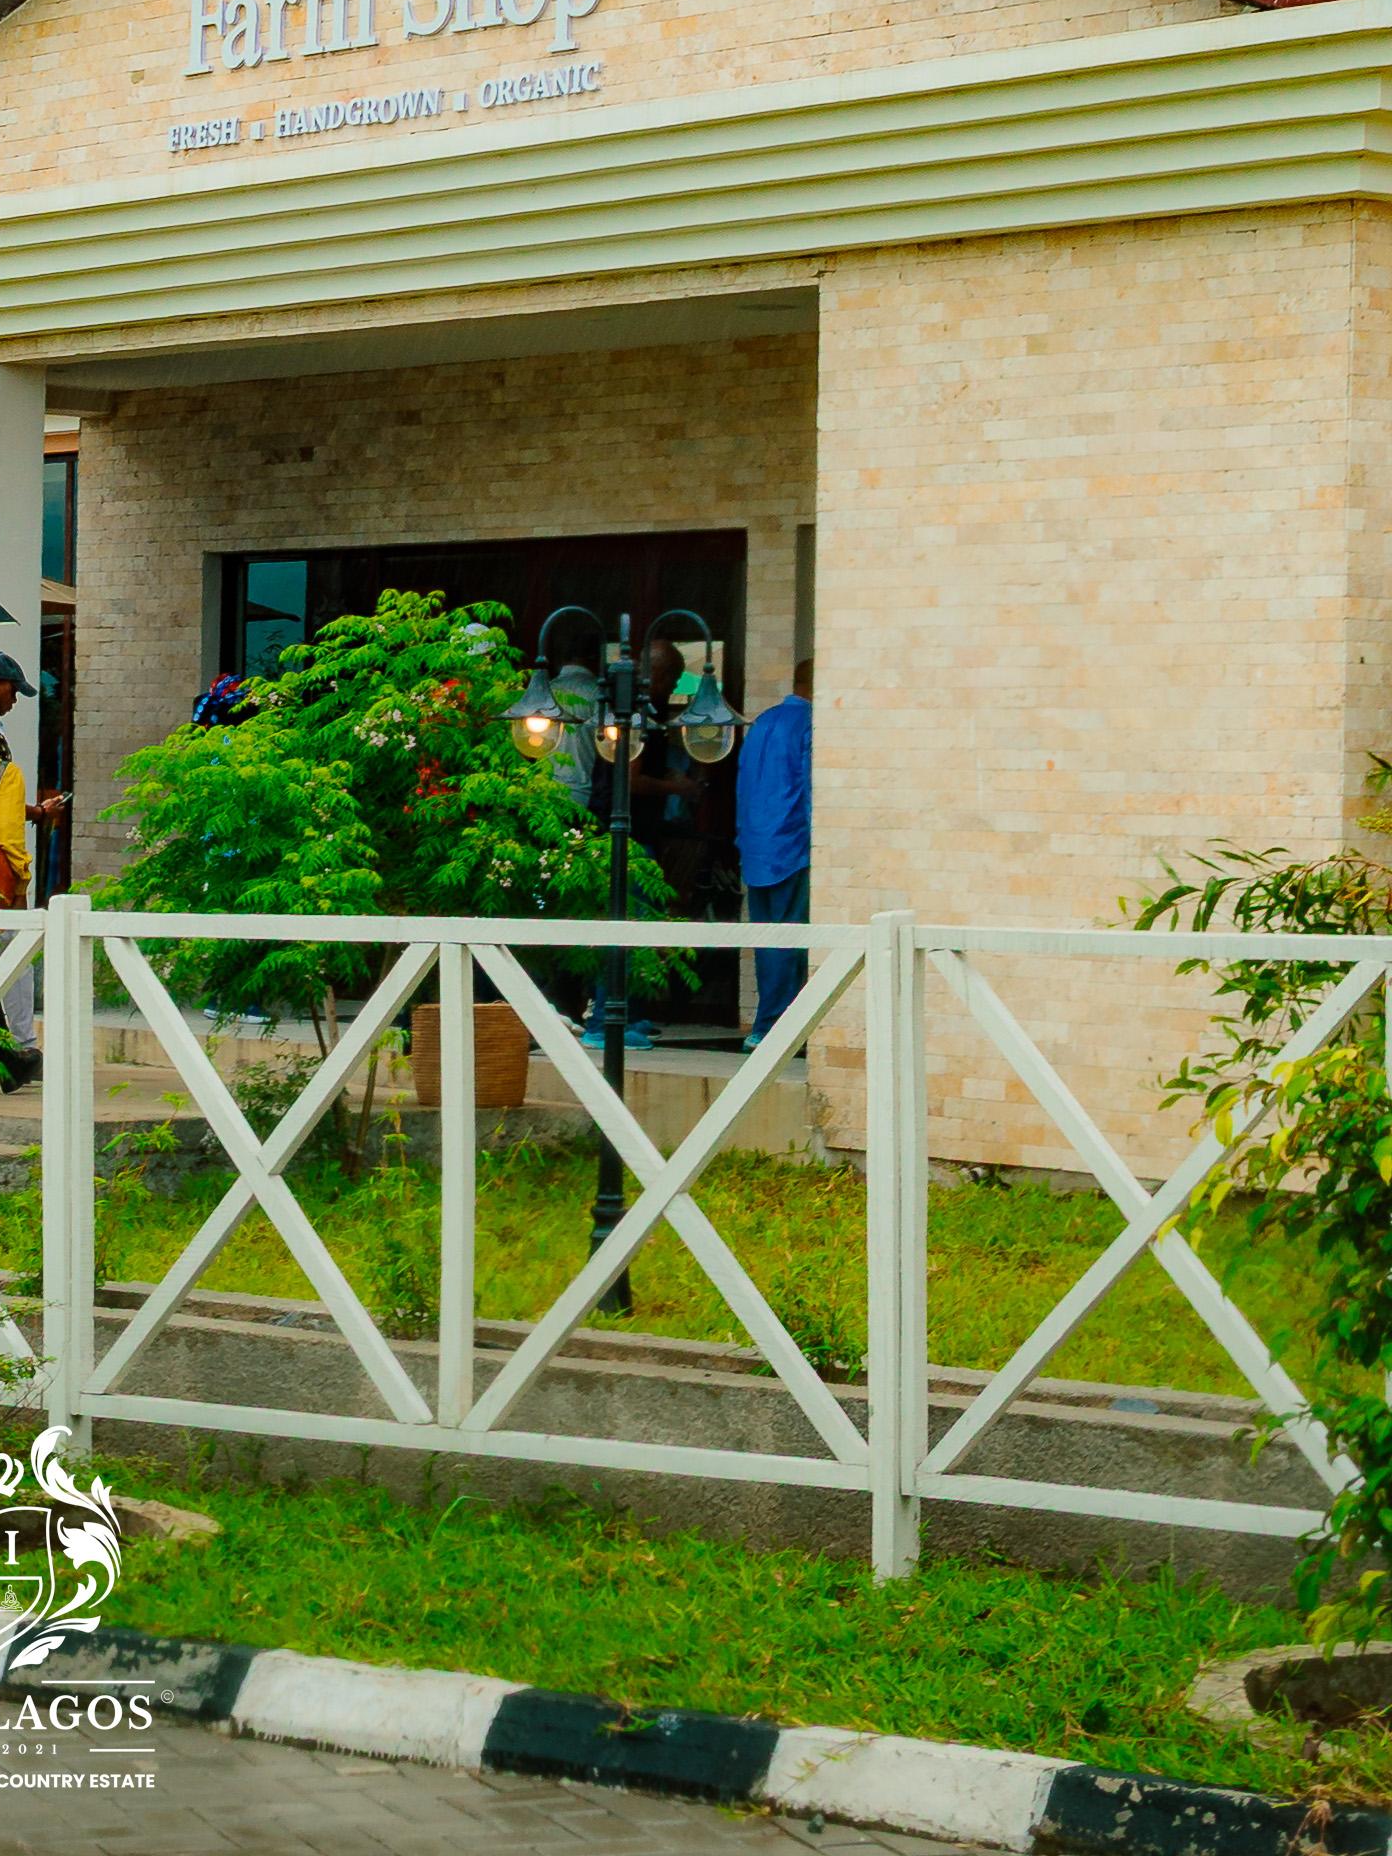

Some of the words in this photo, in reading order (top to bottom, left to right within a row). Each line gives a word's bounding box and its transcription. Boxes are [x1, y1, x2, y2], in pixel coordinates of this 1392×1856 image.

[168, 116, 240, 152] FRESH
[275, 88, 443, 138] HANDGROWN
[478, 60, 602, 109] ORGANIC
